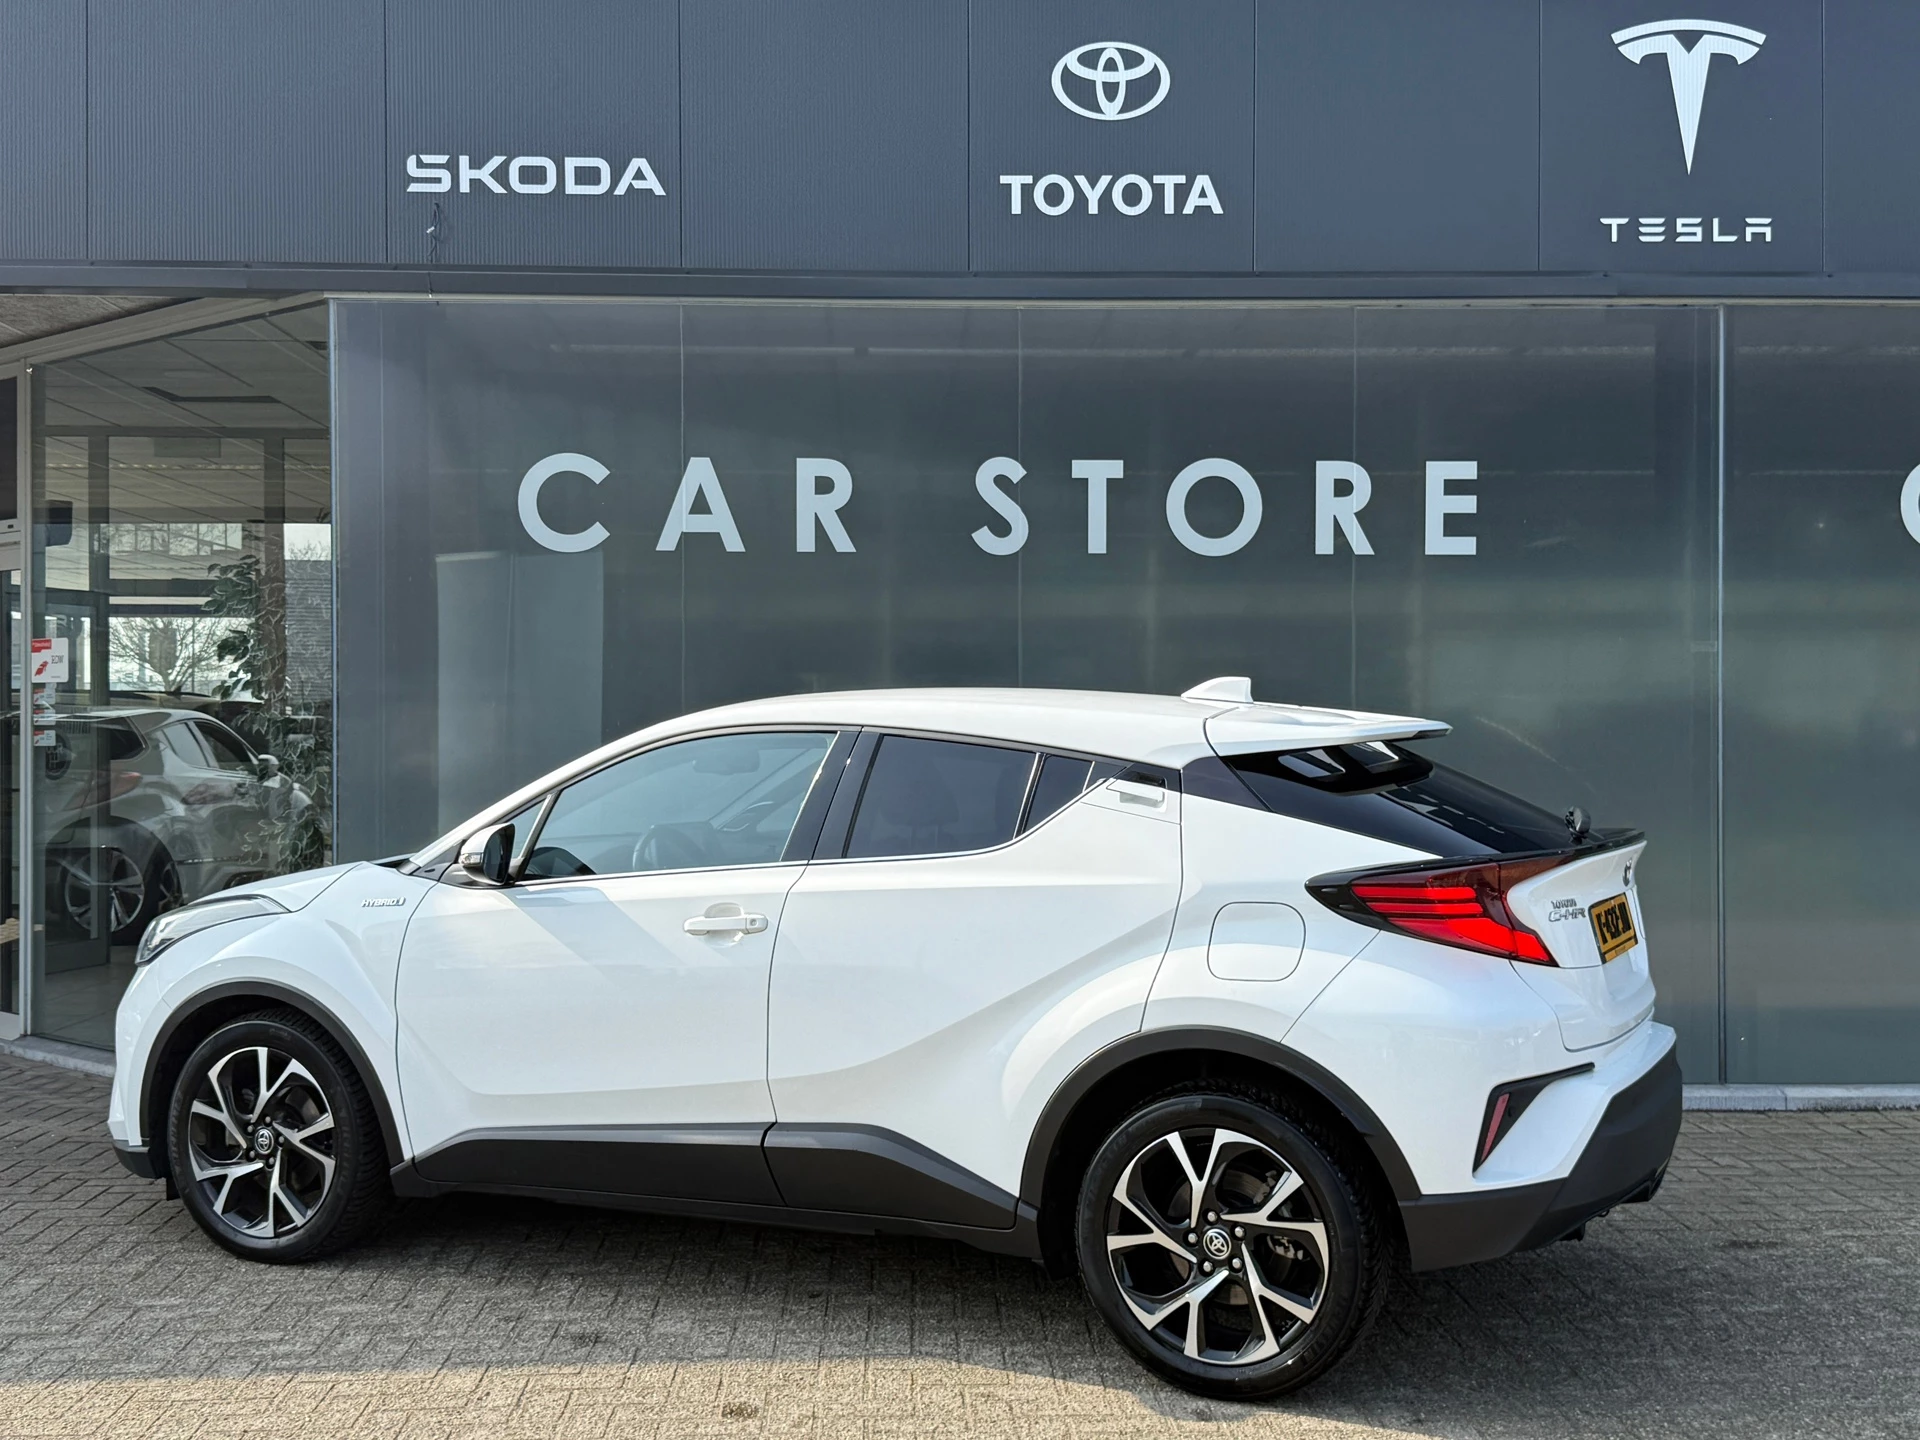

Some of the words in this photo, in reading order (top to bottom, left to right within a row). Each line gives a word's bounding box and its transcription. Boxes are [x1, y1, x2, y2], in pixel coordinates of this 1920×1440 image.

[999, 173, 1225, 217] TOYOTA
[1599, 216, 1773, 244] TESLA
[517, 452, 857, 554] CAR
[971, 456, 1479, 558] STORE
[361, 898, 399, 907] HYBRID
[1548, 907, 1586, 922] C-HR
